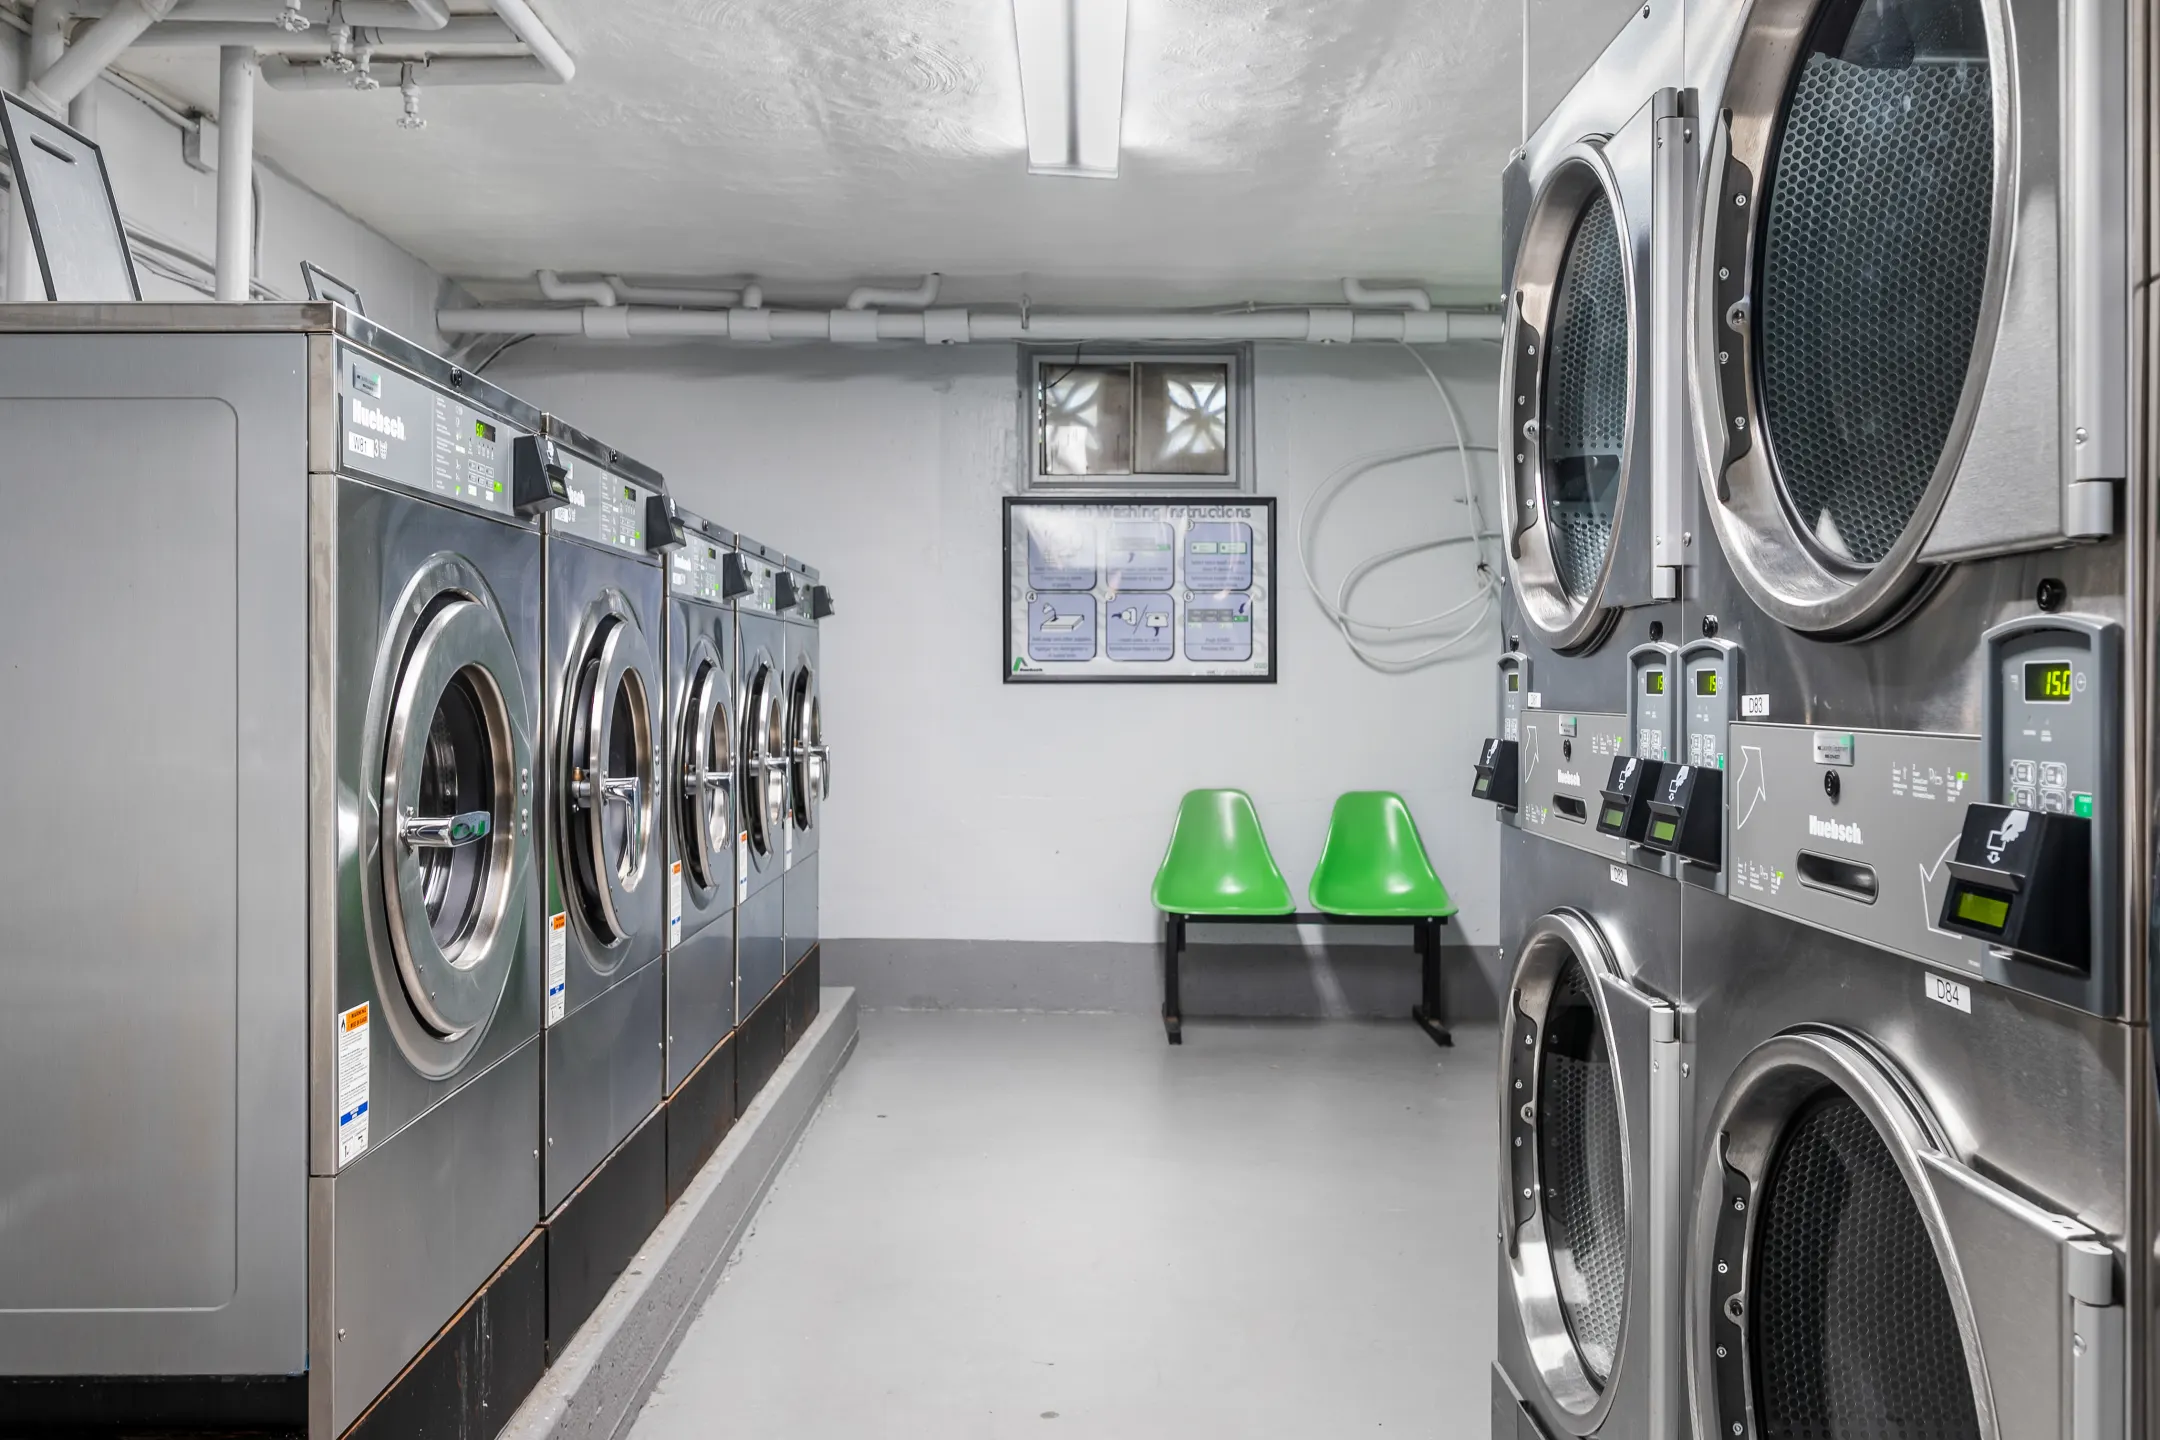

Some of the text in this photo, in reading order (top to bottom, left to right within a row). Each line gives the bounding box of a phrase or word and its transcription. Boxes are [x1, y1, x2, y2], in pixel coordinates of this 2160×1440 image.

[352, 398, 405, 441] Huebsch
[2045, 670, 2071, 695] 150
[1749, 697, 1763, 713] D83
[1809, 814, 1862, 845] Huebsch
[1937, 978, 1959, 1005] D84
